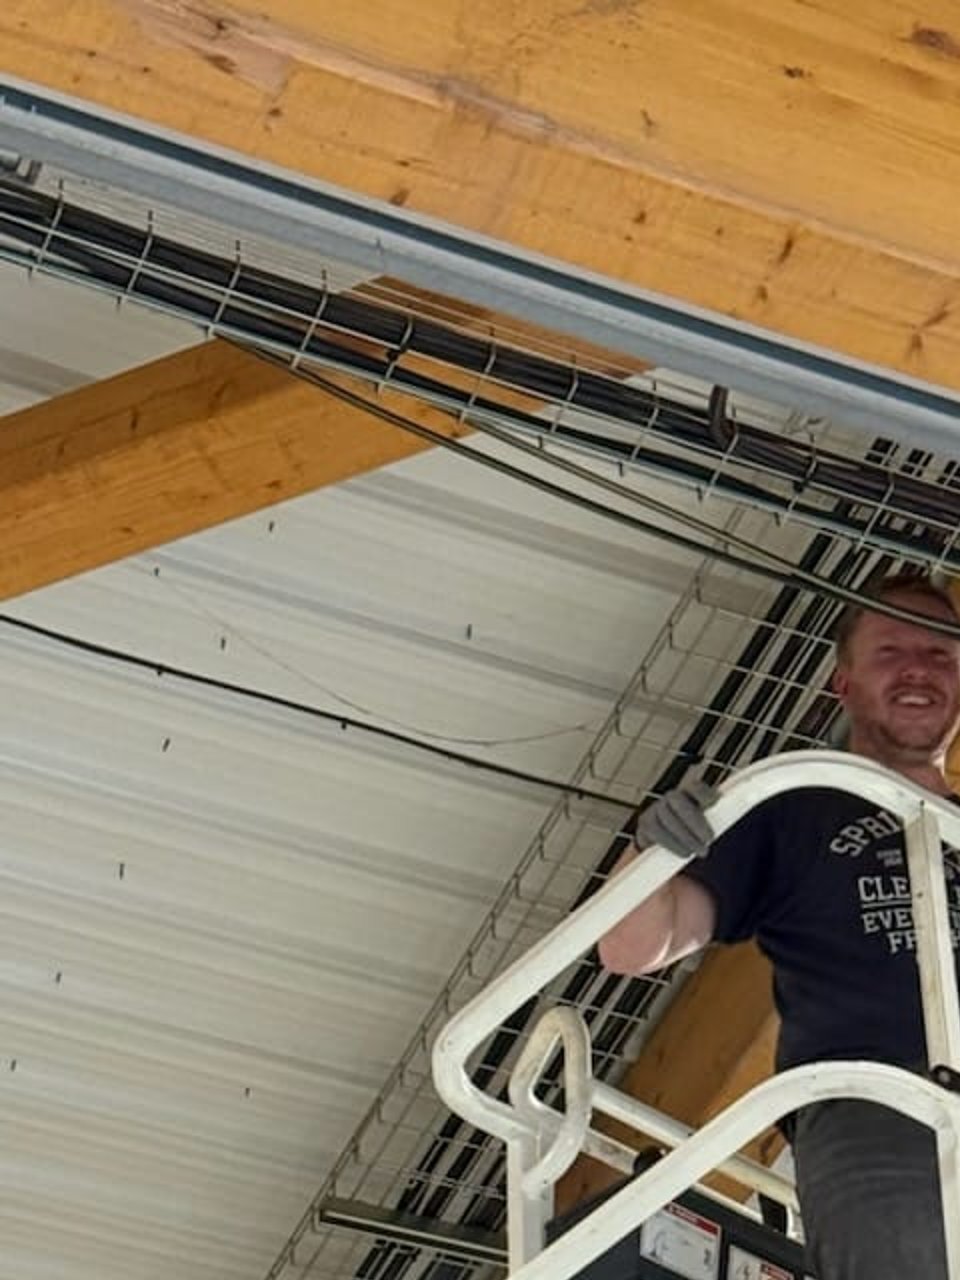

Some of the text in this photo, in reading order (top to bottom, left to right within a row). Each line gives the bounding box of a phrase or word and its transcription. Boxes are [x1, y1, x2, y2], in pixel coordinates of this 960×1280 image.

[830, 811, 902, 857] SPRI
[858, 876, 912, 902] CLE
[861, 908, 913, 934] EVE
